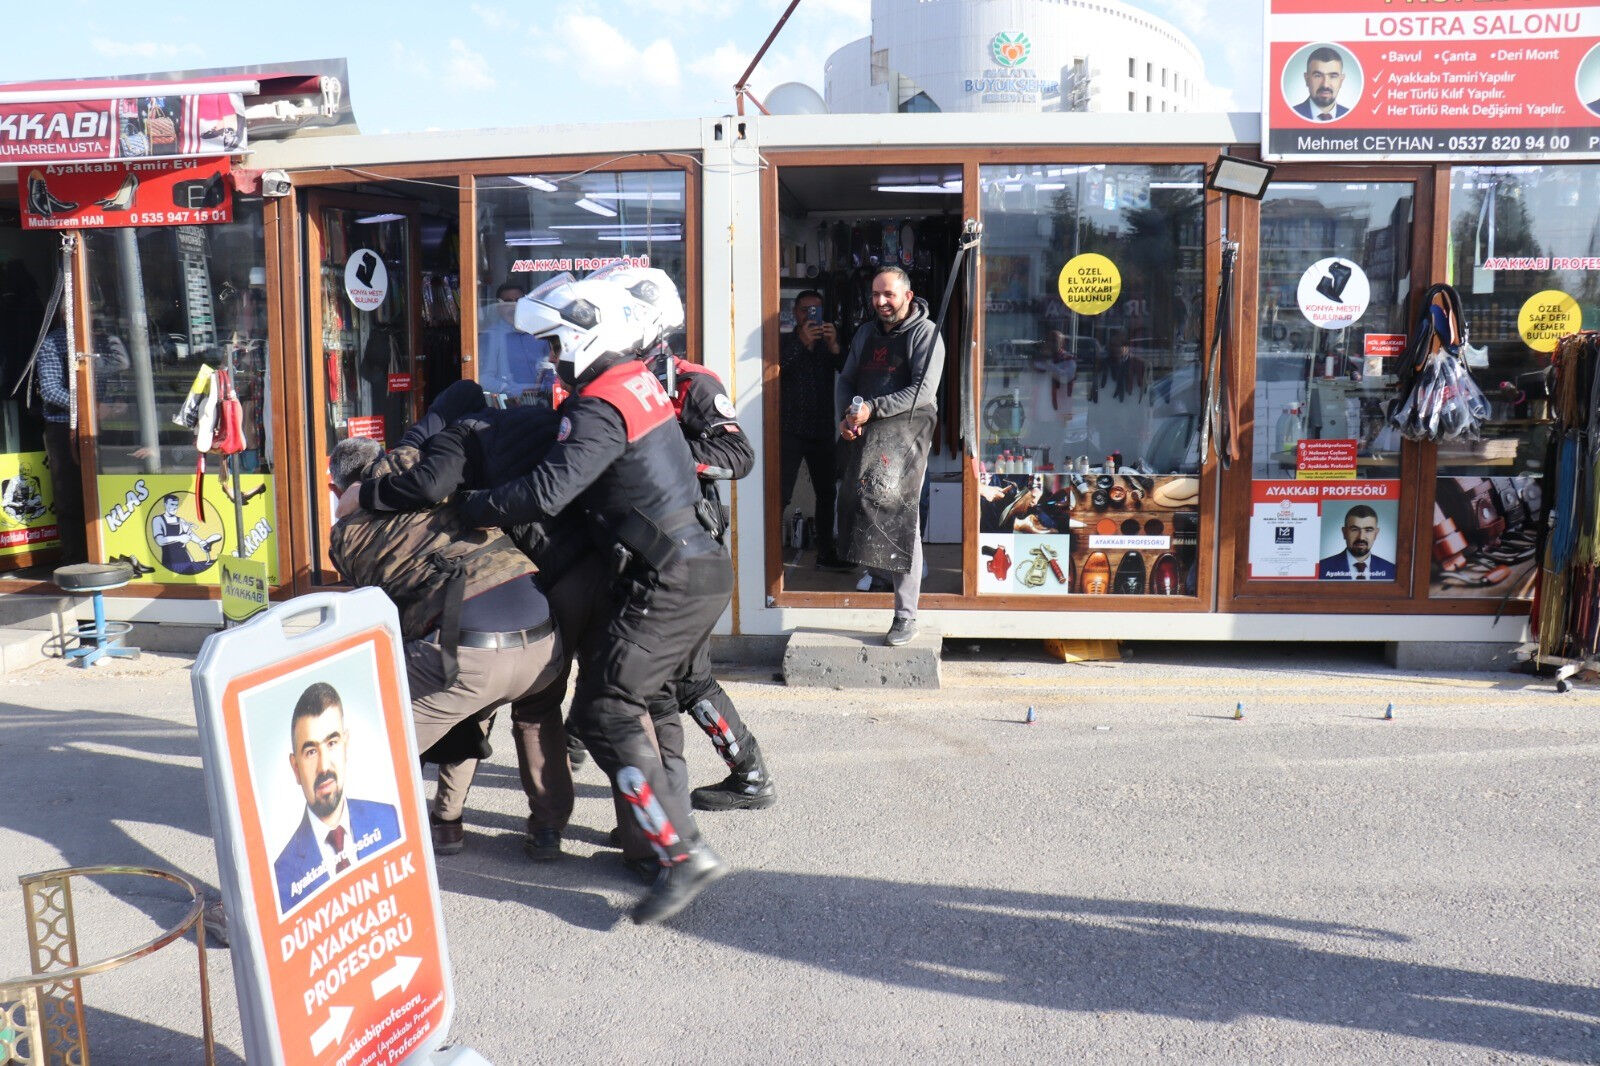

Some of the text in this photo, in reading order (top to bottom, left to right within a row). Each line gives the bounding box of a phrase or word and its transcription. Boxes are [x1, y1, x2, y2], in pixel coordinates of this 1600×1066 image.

[1365, 13, 1581, 37] LOSTRA SALONU
[1389, 48, 1559, 65] Bavul Çanta Deri Mont
[1388, 72, 1516, 85] Ayakkabı Tamiri Yapılır
[1387, 89, 1408, 99] Her
[1410, 88, 1438, 99] Türlü
[1441, 87, 1464, 99] Kılıf
[1387, 105, 1408, 116] Her
[1410, 104, 1438, 115] Türlü
[1440, 104, 1469, 116] Renk
[1471, 103, 1522, 118] Değişimi
[0, 143, 67, 156] UHARREM
[70, 142, 104, 153] USTA
[1298, 137, 1359, 150] Mehmet
[1363, 136, 1433, 150] CEYHAN
[1449, 137, 1485, 150] 0537
[1491, 136, 1521, 149] 820
[1525, 136, 1545, 149] 94
[1550, 136, 1570, 149] 00
[46, 159, 198, 175] Ayakkabı Tamir Evi
[29, 211, 226, 228] Muharrem HAN 0 535 947 15 01
[511, 259, 573, 272] AYAKKABI
[1483, 257, 1549, 271] AYAKKABI
[1067, 276, 1112, 285] EL YAPIMI
[1068, 294, 1112, 302] BULUNUR
[1312, 313, 1353, 321] BULUNUR
[1529, 312, 1570, 322] SAF DERİ
[1533, 322, 1565, 331] KEMER
[1266, 484, 1387, 496] AYAKKABI PROFESÖRÜ
[105, 479, 149, 532] KLAS
[232, 573, 254, 586] KLAS
[225, 584, 265, 604] AYAKKABI
[279, 851, 416, 962] DÜNYANIN İLK
[309, 895, 397, 977] AYAKKABI
[303, 914, 413, 1016] PROFESÖRÜ
